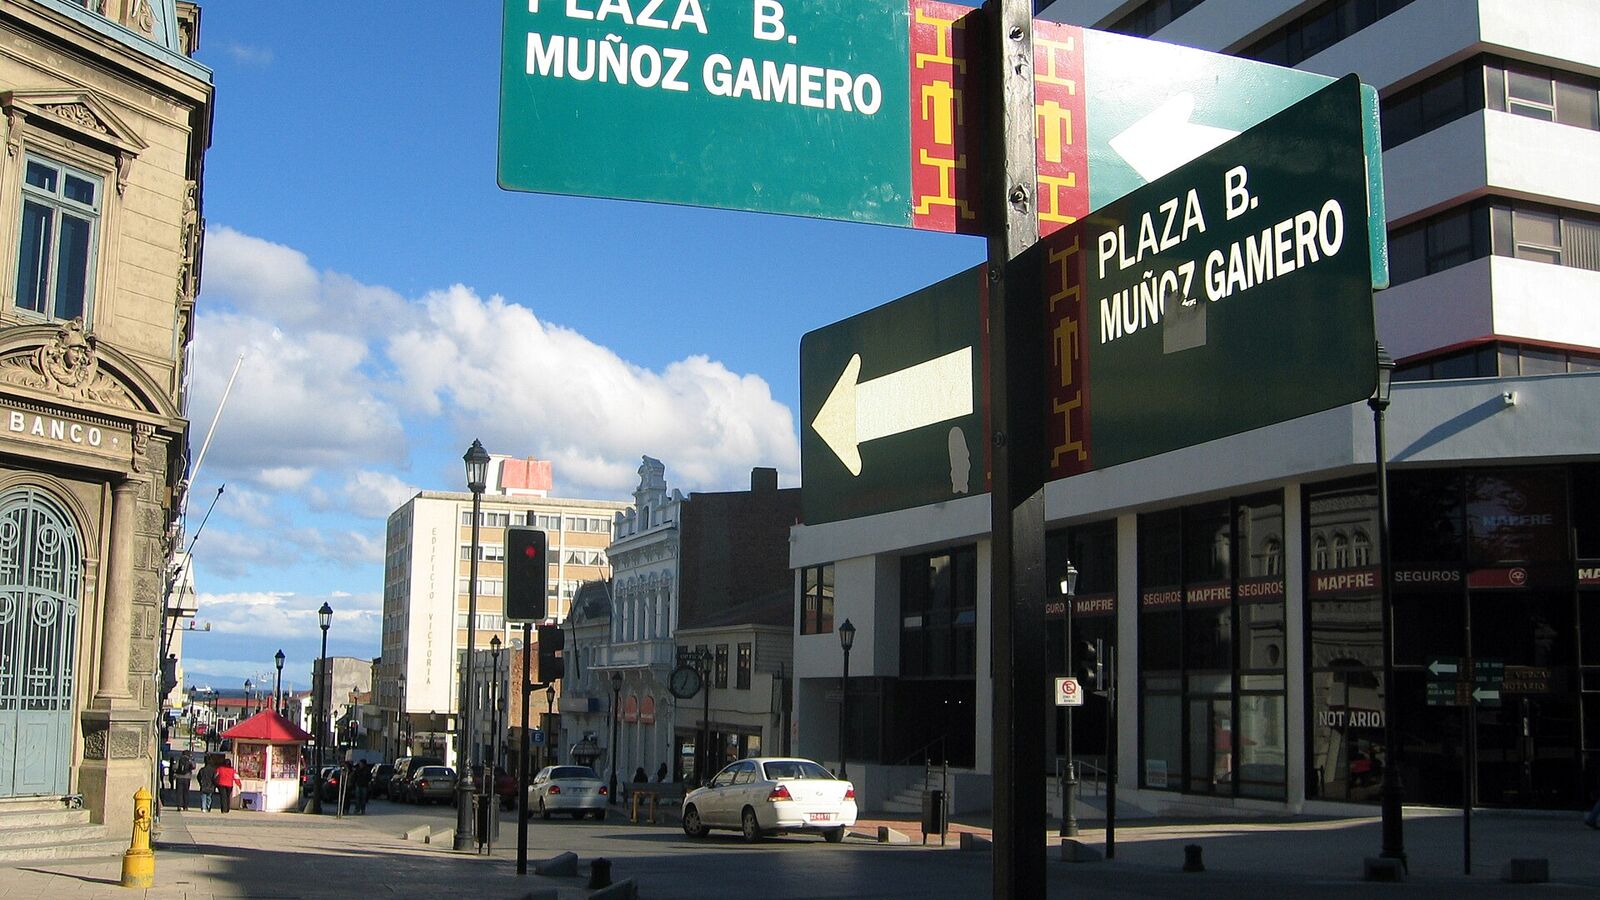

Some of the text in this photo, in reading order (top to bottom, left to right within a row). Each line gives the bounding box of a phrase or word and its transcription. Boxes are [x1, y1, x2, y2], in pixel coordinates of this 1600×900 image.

[753, 0, 797, 44] B.
[525, 32, 883, 115] MUÑOZ GAMERO
[1098, 165, 1259, 280] PLAZA B.
[1204, 199, 1344, 302] GAMERO
[9, 410, 102, 447] BANCO
[429, 527, 437, 600] EDIFICIO
[1317, 572, 1375, 592] MAPFRE
[1394, 570, 1461, 583] SEGUROS
[1077, 599, 1114, 613] MAPFRE
[1143, 580, 1284, 606] SEGUROS MAPFRE SEGUROS
